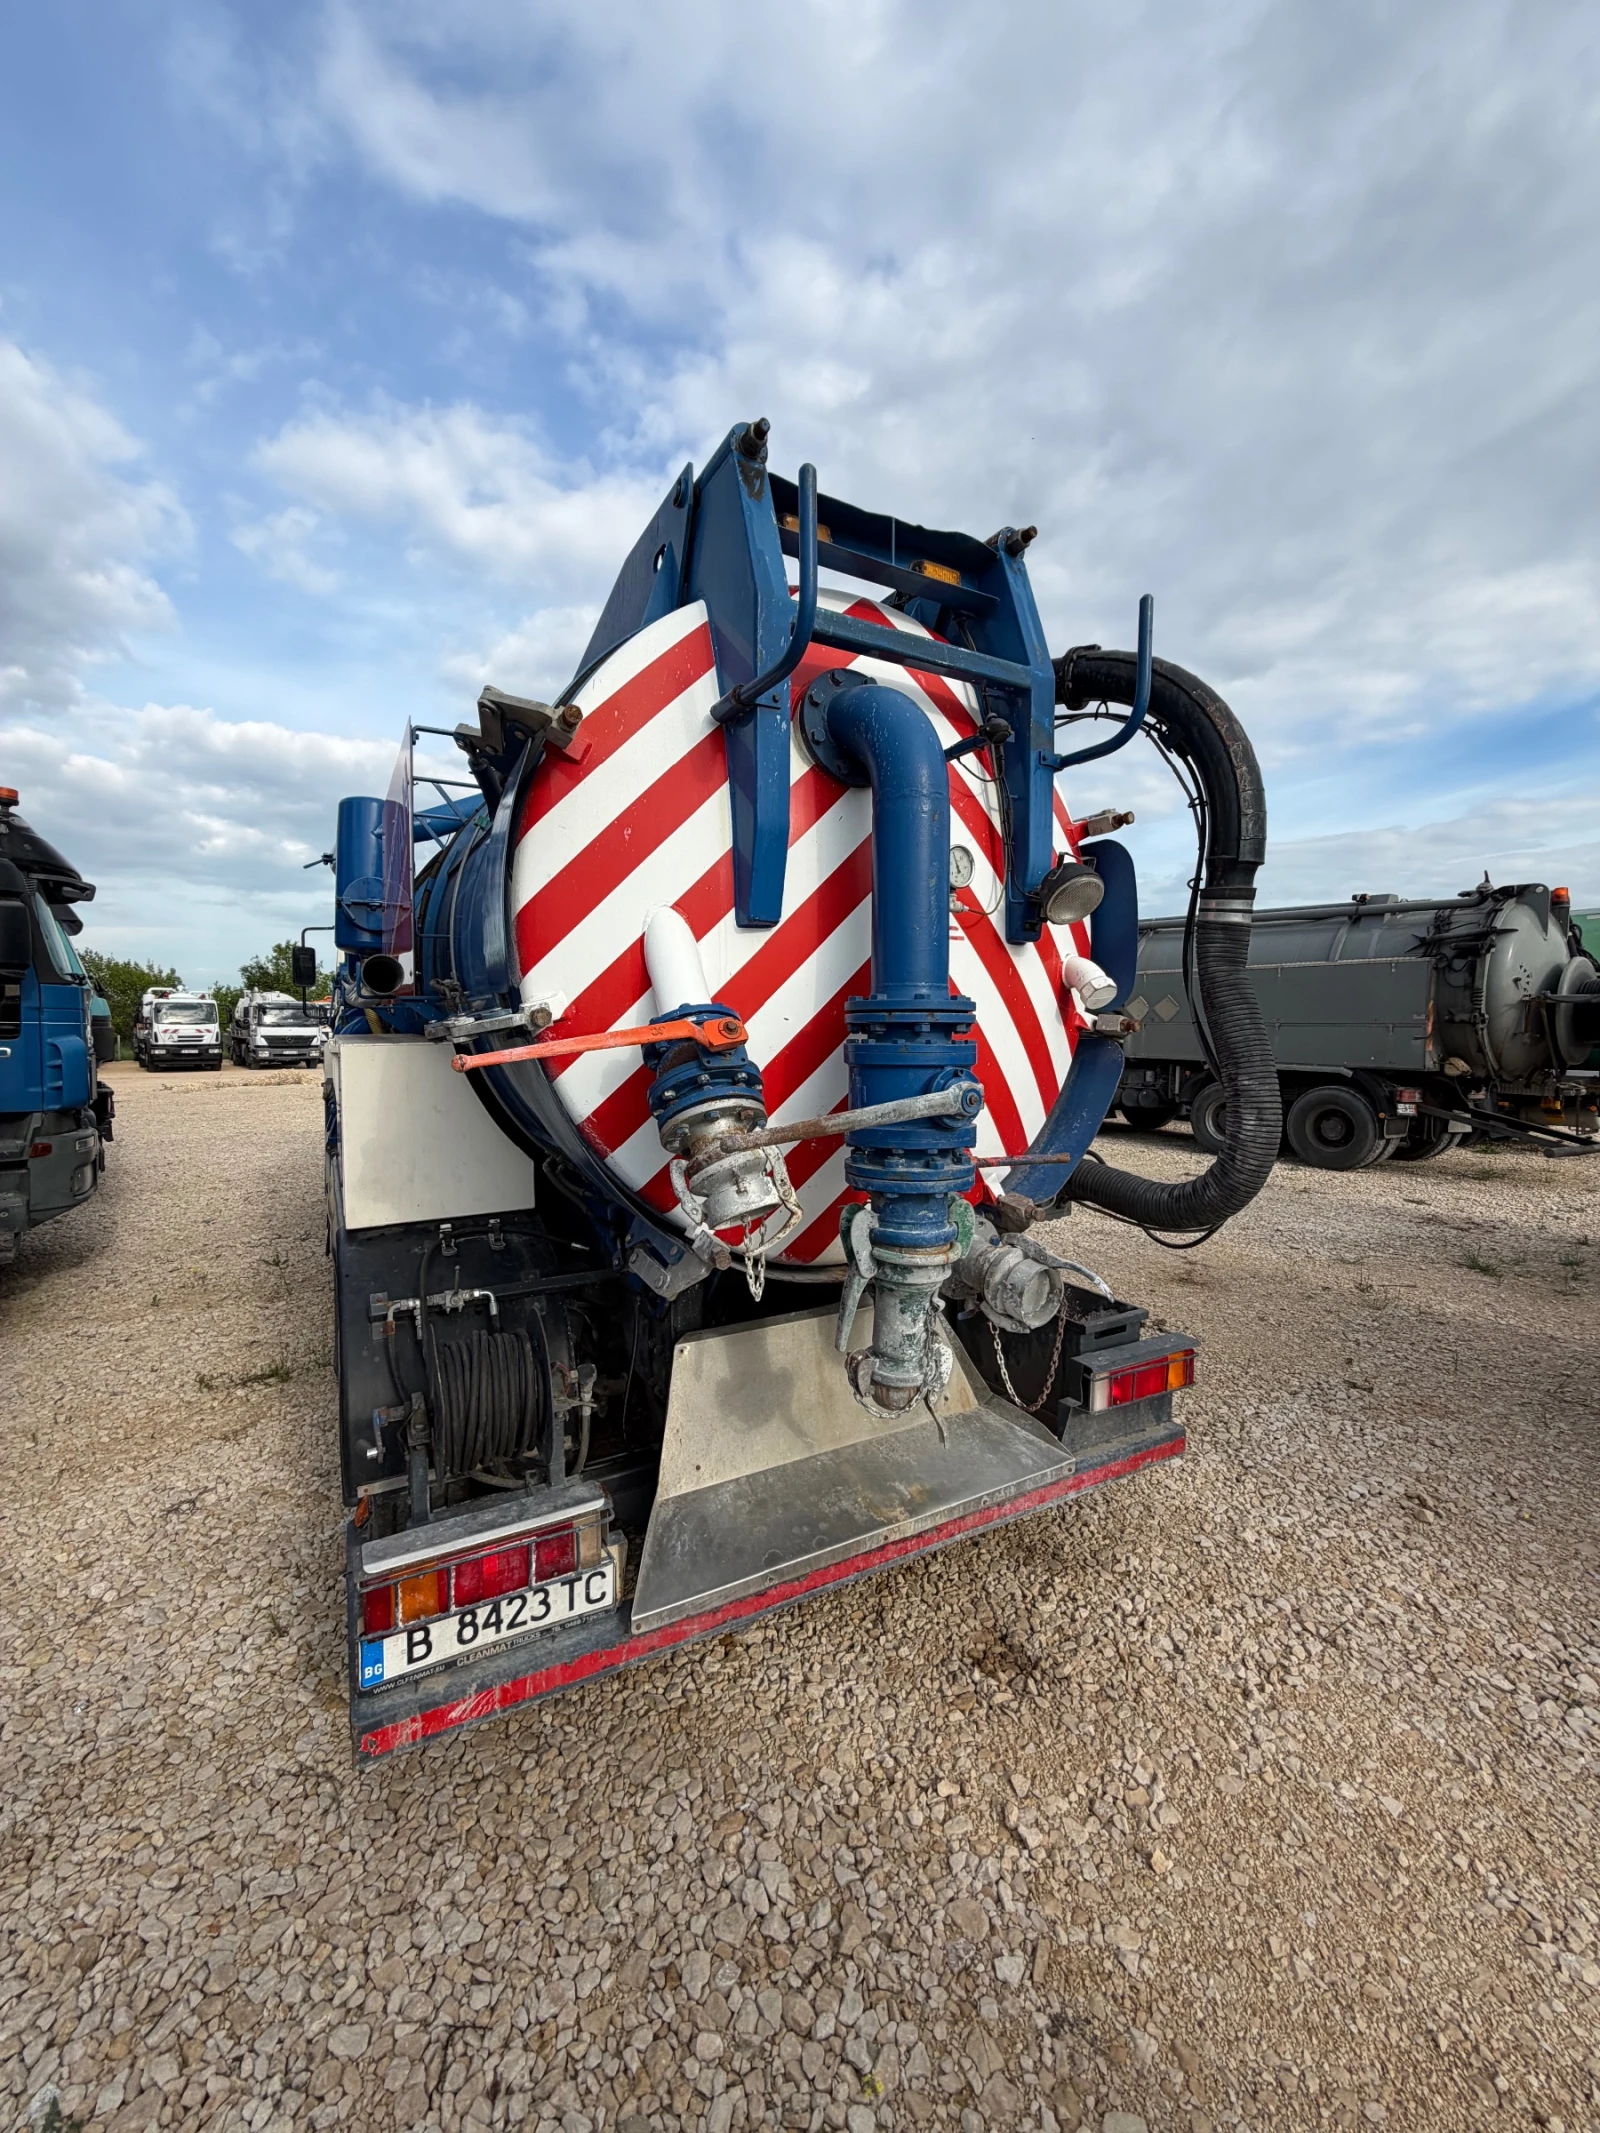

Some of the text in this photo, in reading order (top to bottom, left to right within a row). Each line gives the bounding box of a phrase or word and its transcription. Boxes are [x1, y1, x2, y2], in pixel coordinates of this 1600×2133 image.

[407, 1570, 607, 1665] B 8423 TC
[456, 1640, 513, 1667] CLEANMAT
[364, 1663, 383, 1679] BG
